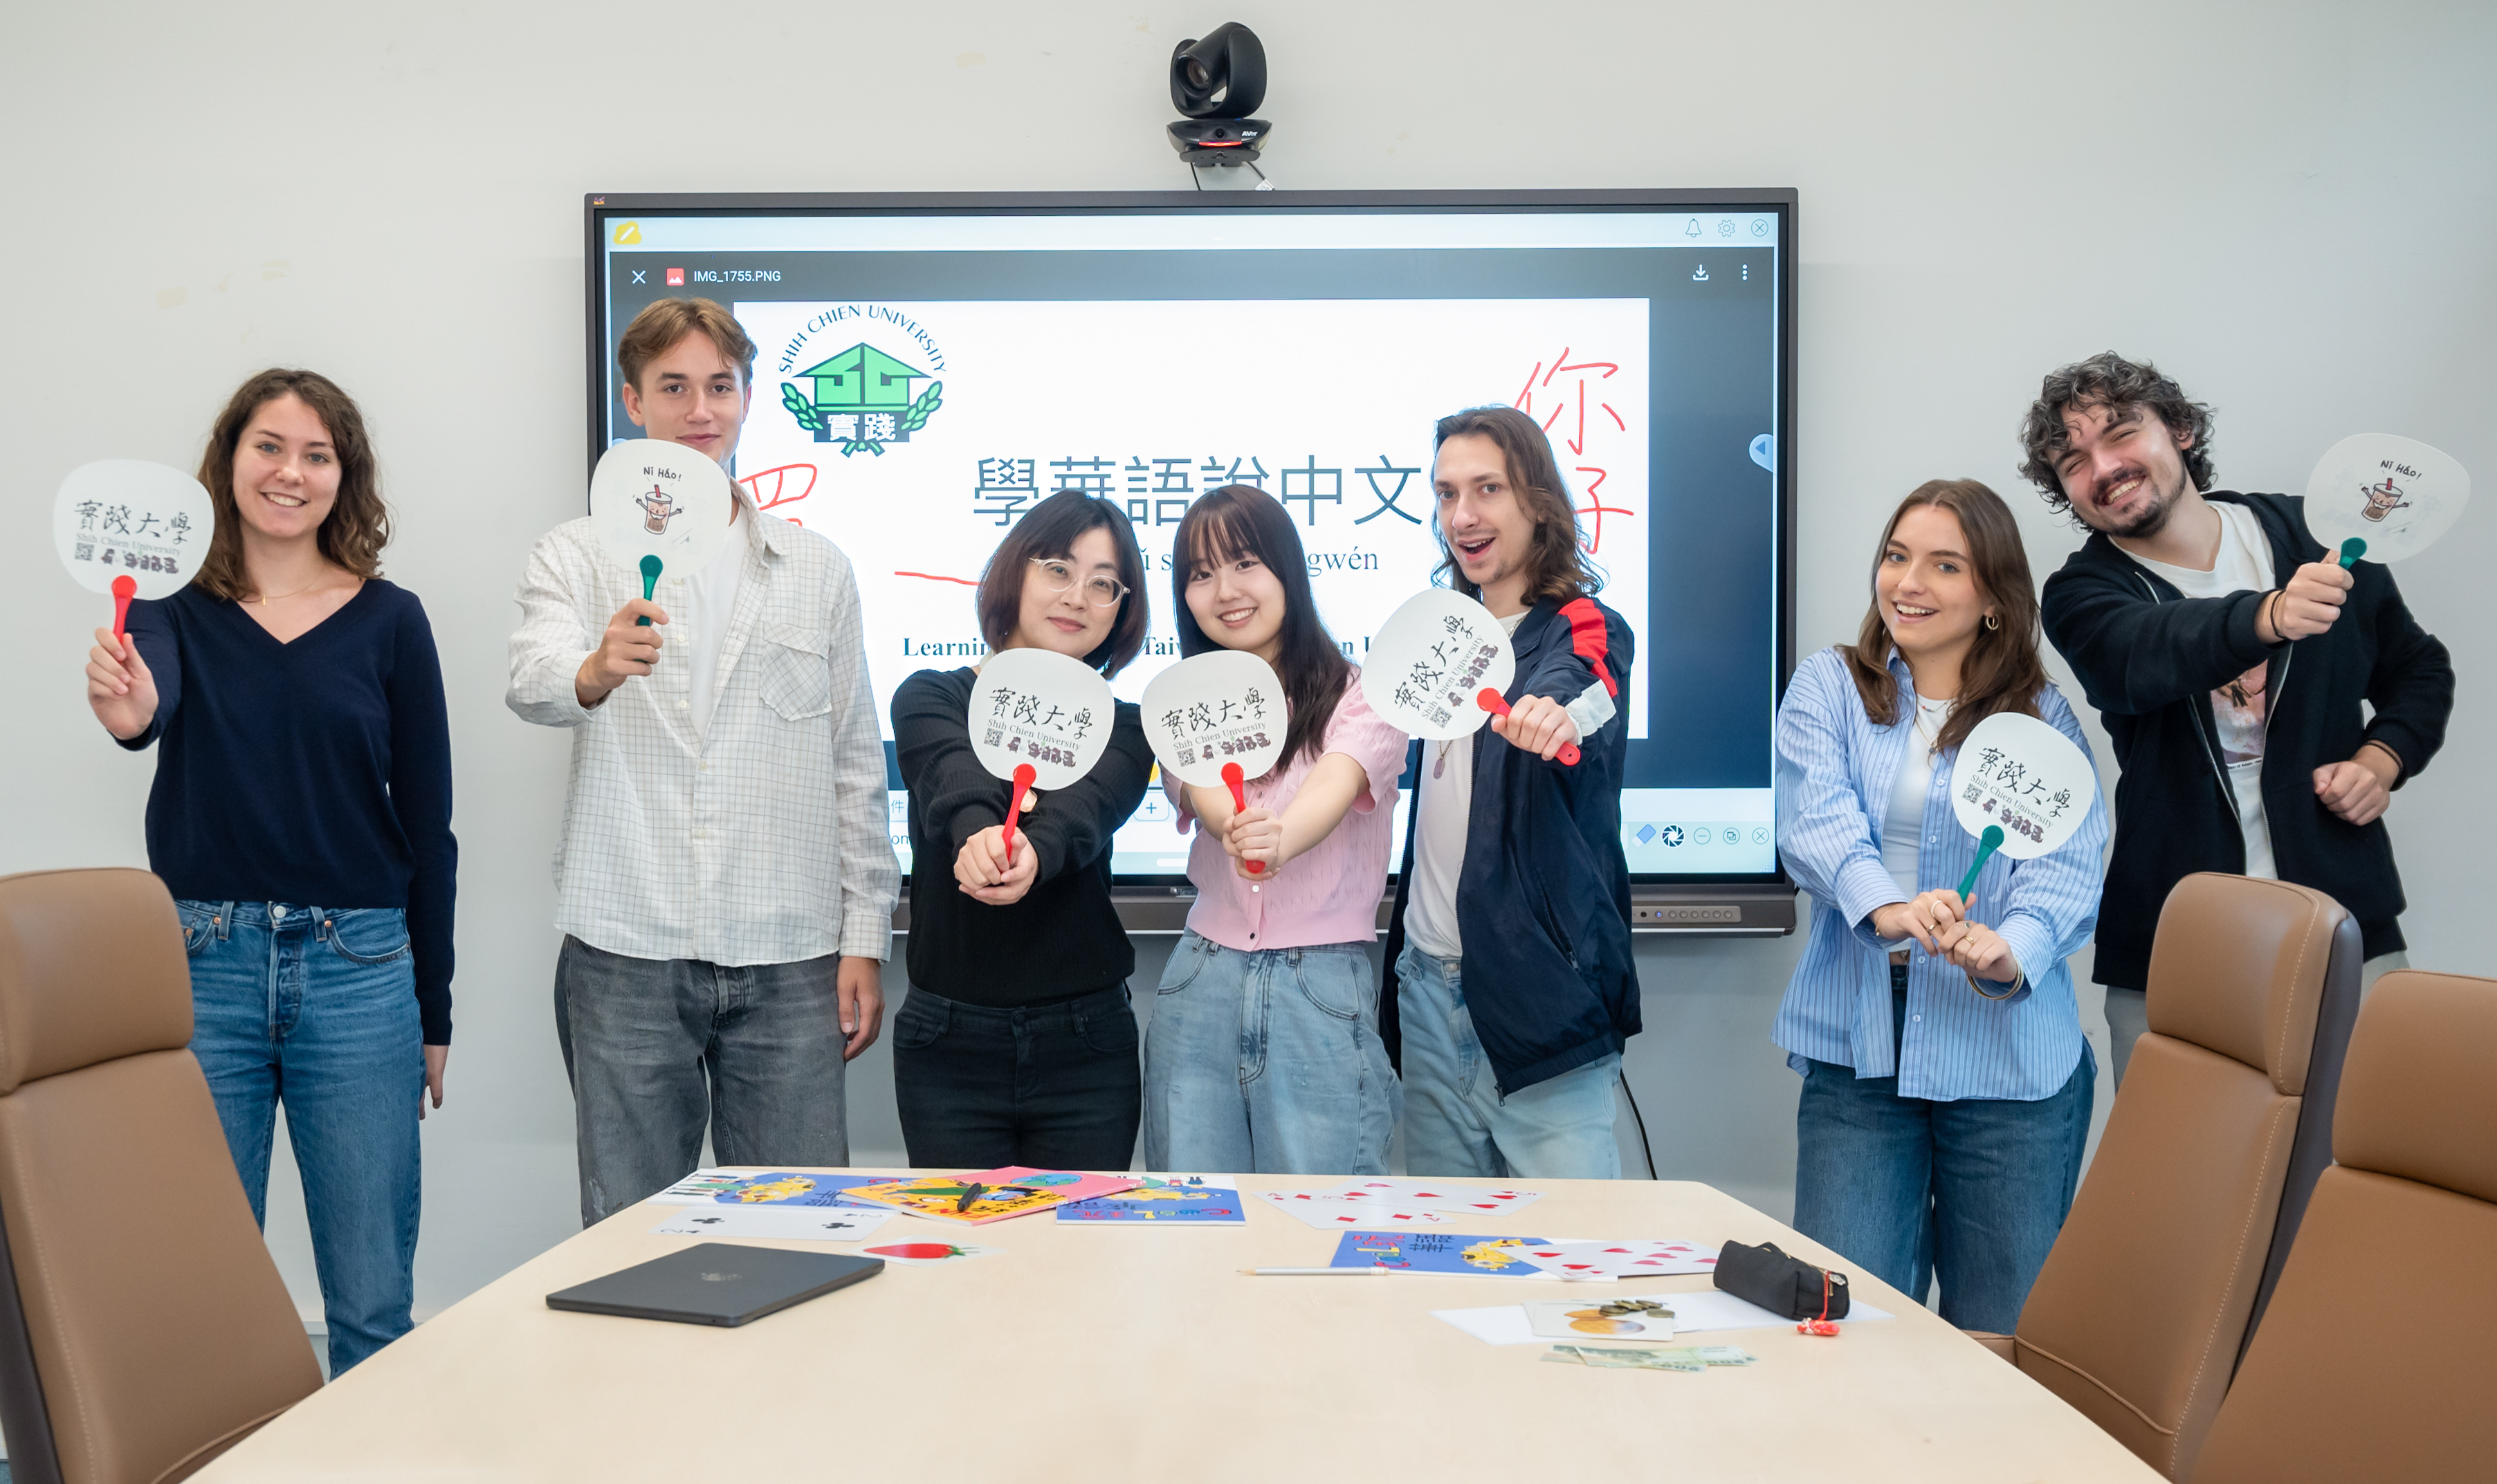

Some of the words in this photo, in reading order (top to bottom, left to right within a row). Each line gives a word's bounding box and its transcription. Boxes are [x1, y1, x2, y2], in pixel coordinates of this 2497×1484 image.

[694, 271, 781, 283] IMG_1755.PNG
[779, 332, 807, 374] SHIH
[807, 304, 861, 333] CHIEN
[868, 304, 946, 372] UNIVERSITY
[827, 413, 897, 441] 實踐
[76, 533, 98, 544] Shih
[100, 536, 129, 549] Chien
[132, 540, 182, 558] University
[1421, 701, 1438, 720] Shih
[1435, 676, 1454, 700] Chien
[1452, 635, 1484, 676] University
[987, 719, 1007, 731] Shih
[1009, 724, 1034, 738] Chien
[1037, 732, 1081, 751] University
[1173, 740, 1193, 751] Shih
[1195, 733, 1220, 745] Chien
[1223, 722, 1267, 738] University
[1970, 774, 1988, 790] Shih
[1990, 785, 2013, 804] Chien
[2014, 800, 2054, 829] University
